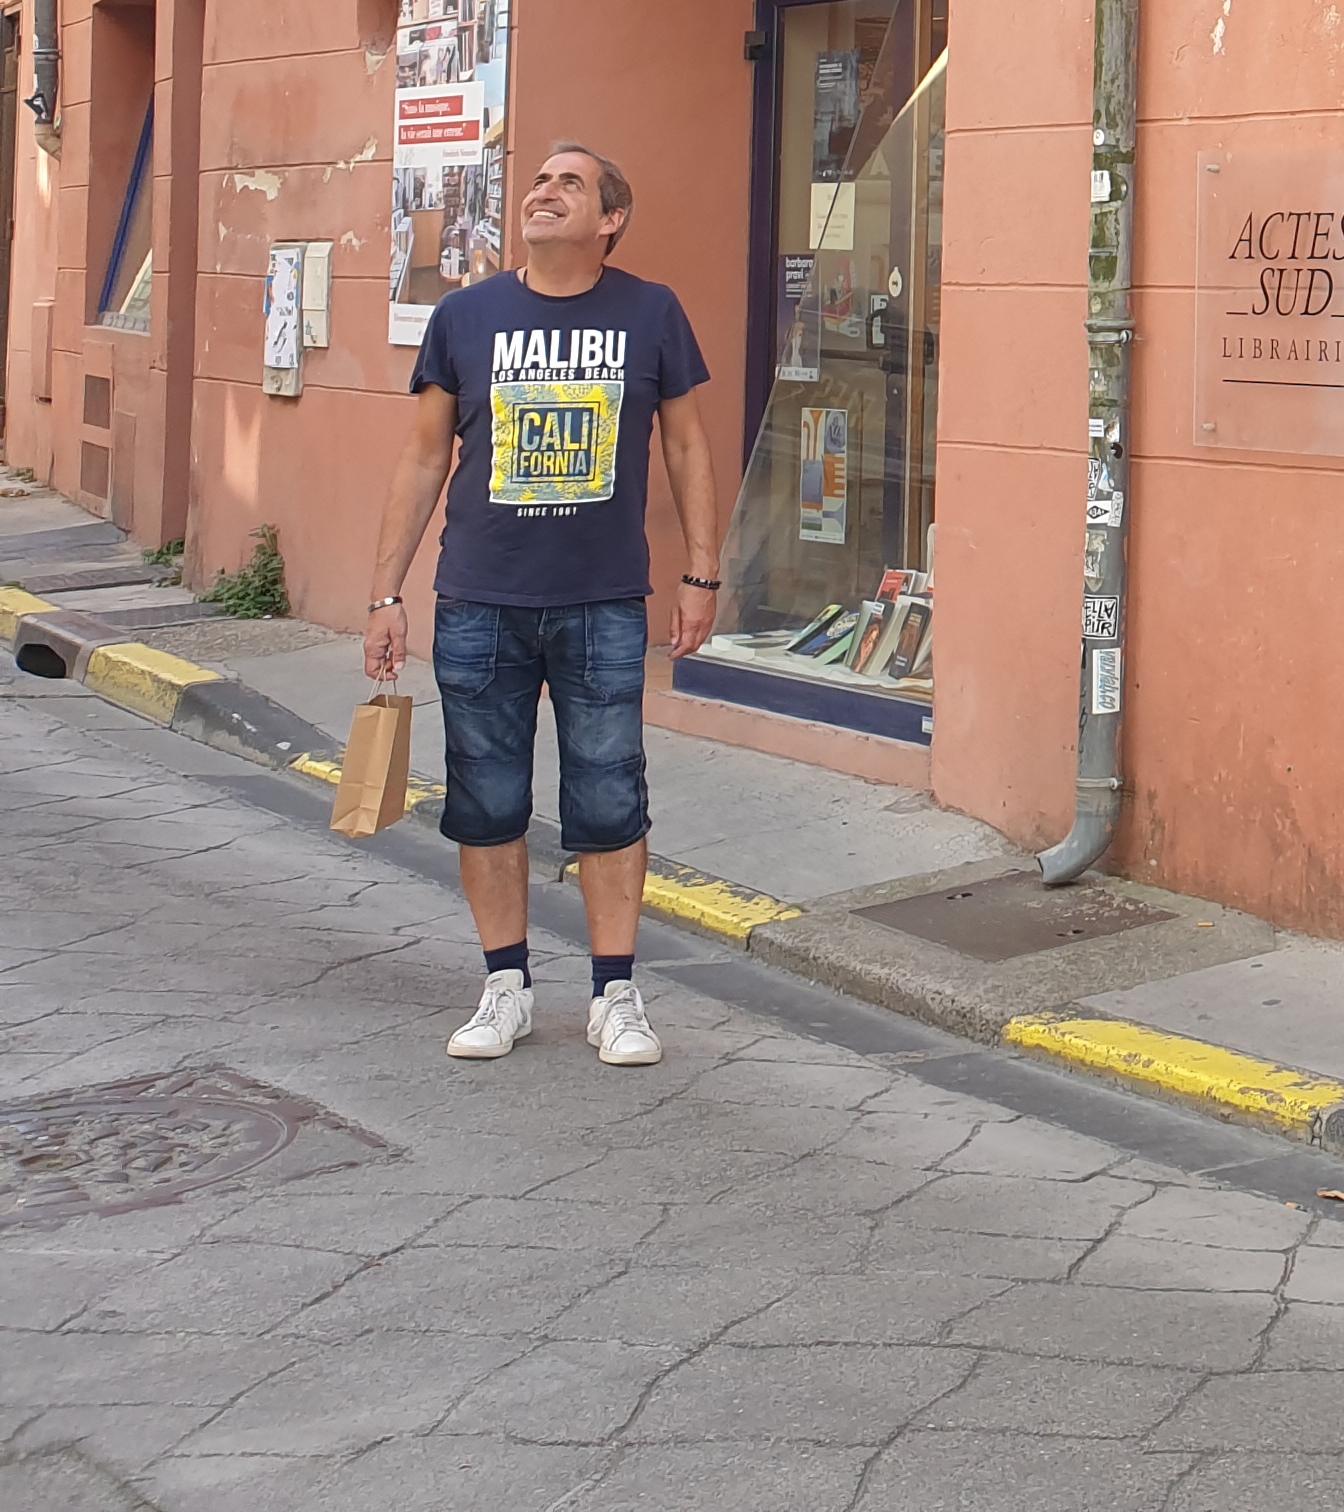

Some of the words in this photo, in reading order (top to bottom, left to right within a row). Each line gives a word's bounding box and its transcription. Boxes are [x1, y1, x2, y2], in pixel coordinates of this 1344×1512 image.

[1252, 267, 1334, 316] SUD
[493, 329, 627, 372] MALIBU
[491, 369, 514, 382] LOS
[518, 368, 576, 381] ANGELES
[584, 366, 625, 381] BEACH
[520, 411, 590, 451] CALI
[519, 450, 588, 476] FORNIA
